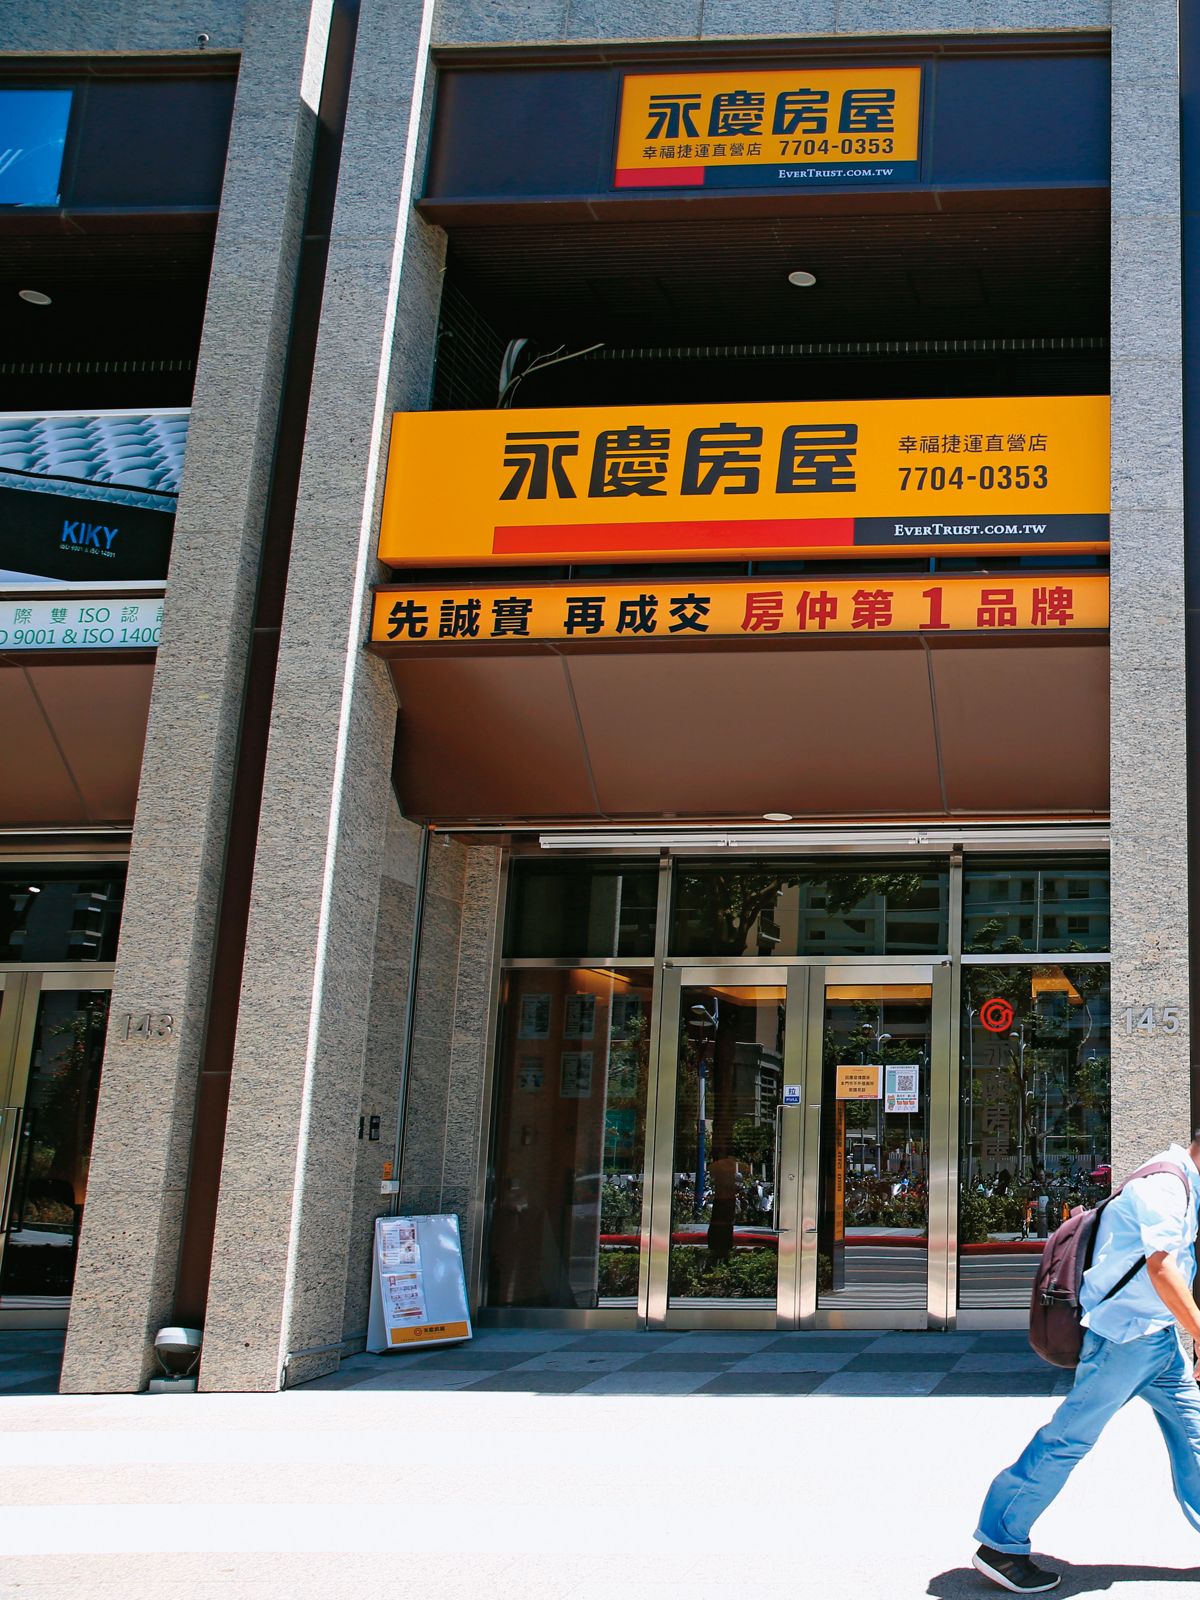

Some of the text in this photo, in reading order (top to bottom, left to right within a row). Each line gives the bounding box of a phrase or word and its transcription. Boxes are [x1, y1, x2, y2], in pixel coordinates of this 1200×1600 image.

[646, 88, 895, 139] 永慶房屋
[642, 138, 894, 160] 幸福捷運直營店 7704-0353
[898, 434, 1048, 455] 幸福捷運直營店
[499, 422, 858, 501] 永慶房屋
[898, 465, 1049, 492] 7704-0353
[62, 520, 118, 549] KIKY
[387, 586, 1076, 639] 先誠實 再成交 房仲第1品牌
[14, 629, 55, 644] 9001
[62, 629, 78, 644] &
[82, 628, 114, 644] ISO
[119, 1013, 174, 1041] 143
[1122, 1007, 1181, 1034] 145
